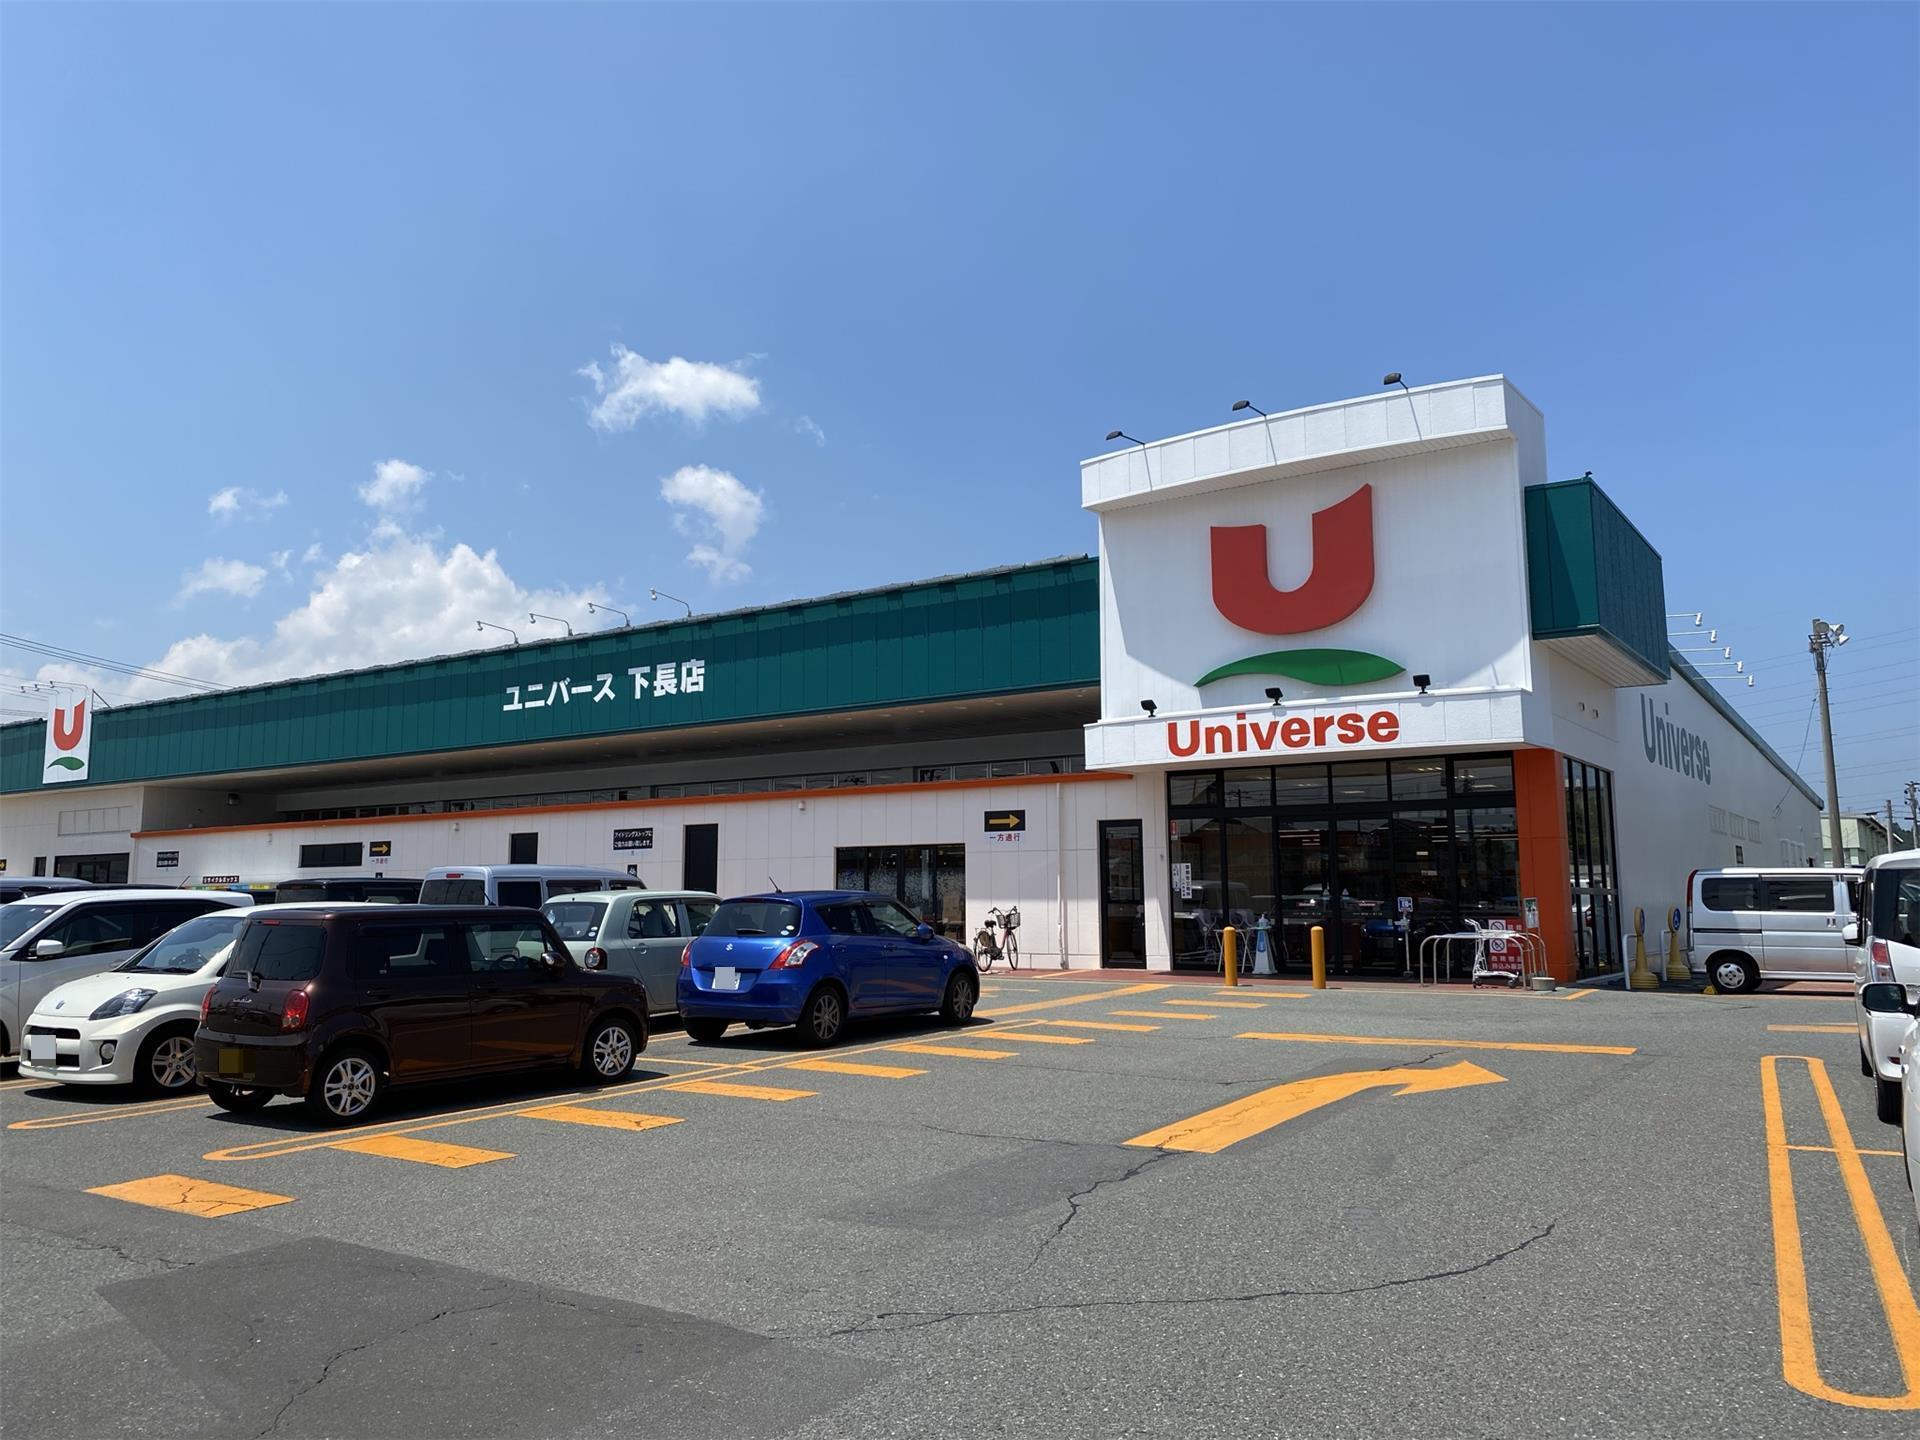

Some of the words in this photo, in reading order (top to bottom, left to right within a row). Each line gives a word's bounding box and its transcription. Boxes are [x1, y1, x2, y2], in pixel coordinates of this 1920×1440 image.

[1210, 483, 1374, 635] U
[503, 672, 616, 712] ユニバース
[627, 658, 705, 700] 下長店
[1167, 711, 1400, 757] Universe
[1640, 693, 1711, 785] Universe
[989, 833, 1020, 842] 一方通行
